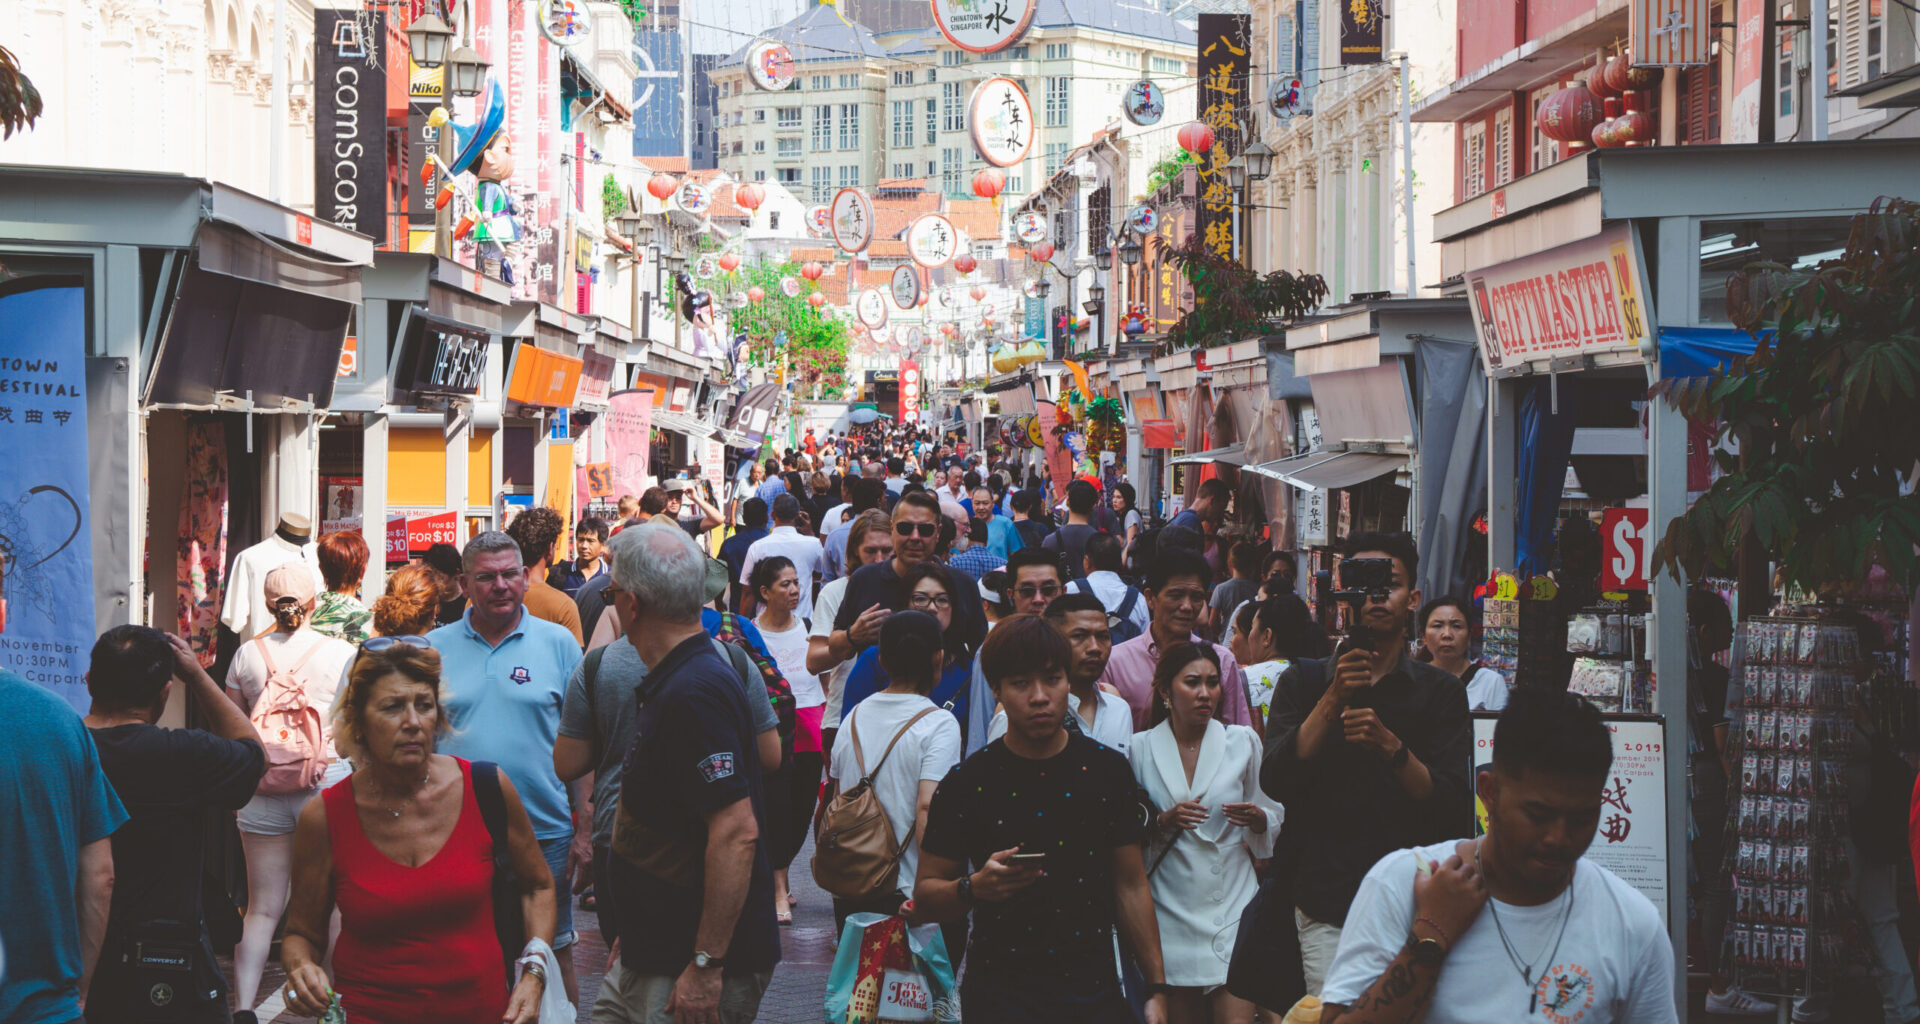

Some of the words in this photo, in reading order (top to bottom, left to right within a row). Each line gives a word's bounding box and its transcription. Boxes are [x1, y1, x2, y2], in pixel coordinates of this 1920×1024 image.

[950, 13, 983, 22] CHINATOWN
[984, 2, 1016, 34] 水
[950, 22, 983, 31] SINGAPORE
[411, 83, 441, 94] Niko
[510, 30, 525, 137] CHINATOWN
[1491, 260, 1624, 356] GIFTMASTER
[1624, 297, 1643, 340] SG
[589, 466, 611, 492] $1
[446, 521, 455, 529] $3
[409, 533, 431, 542] FOR
[433, 531, 455, 542] $10
[1, 638, 79, 654] November
[8, 654, 69, 668] 10:30PM
[26, 670, 87, 685] Carpark
[1624, 743, 1661, 752] 2019
